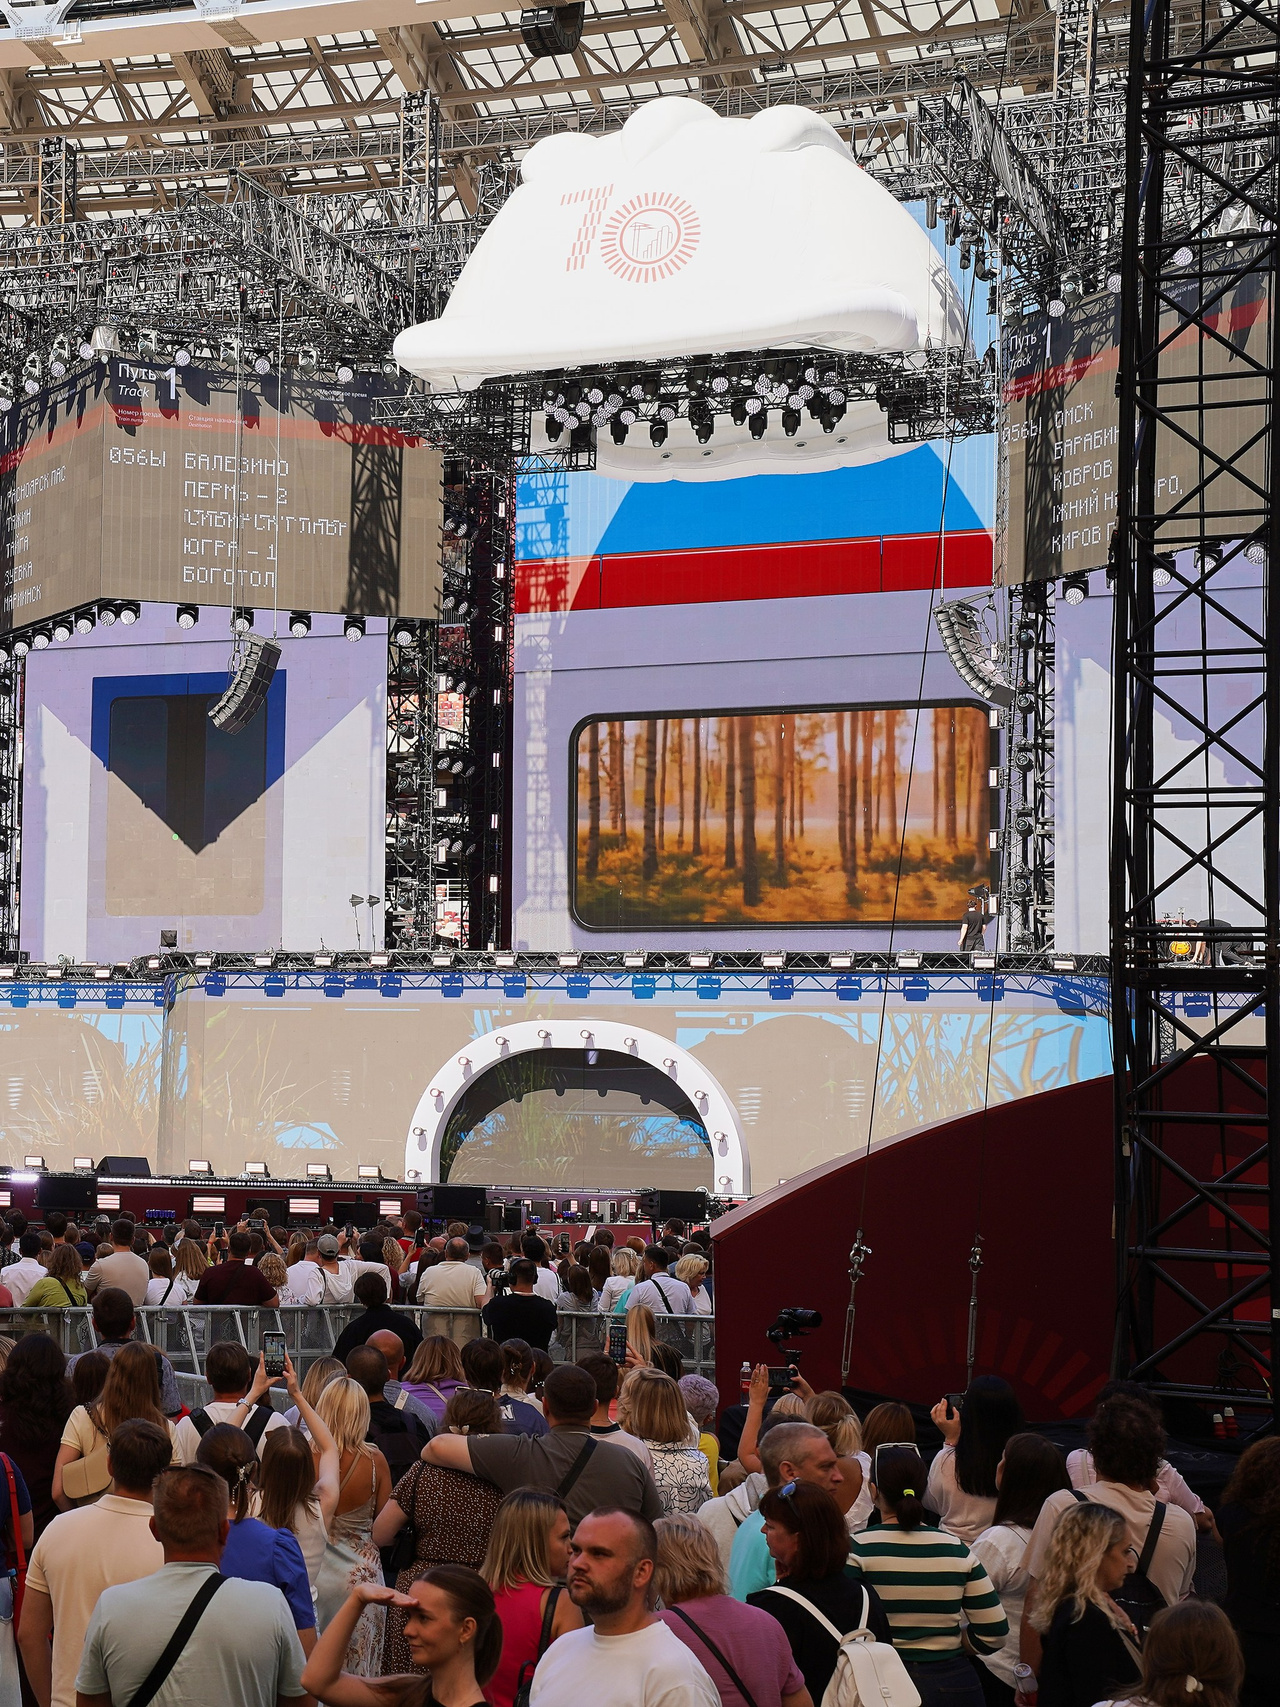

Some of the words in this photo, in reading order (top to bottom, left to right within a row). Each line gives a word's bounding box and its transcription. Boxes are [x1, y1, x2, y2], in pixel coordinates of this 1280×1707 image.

[1010, 334, 1037, 352] Путь
[1042, 323, 1051, 358] 1
[118, 363, 157, 382] Путь
[1010, 355, 1031, 369] Track
[118, 385, 149, 398] Track
[164, 367, 176, 400] 1
[1055, 401, 1094, 429] ОМСК
[109, 446, 166, 467] 056Ы
[184, 452, 289, 476] БАЛЕЗИНО
[1053, 459, 1113, 491] КОВРОВ
[184, 480, 249, 501] ПЕРМЬ
[277, 488, 287, 504] 2
[184, 537, 238, 557] ЮГРА
[267, 543, 276, 561] 1
[1051, 525, 1101, 553] КИРОВ
[183, 566, 275, 588] БОГОТОЛ
